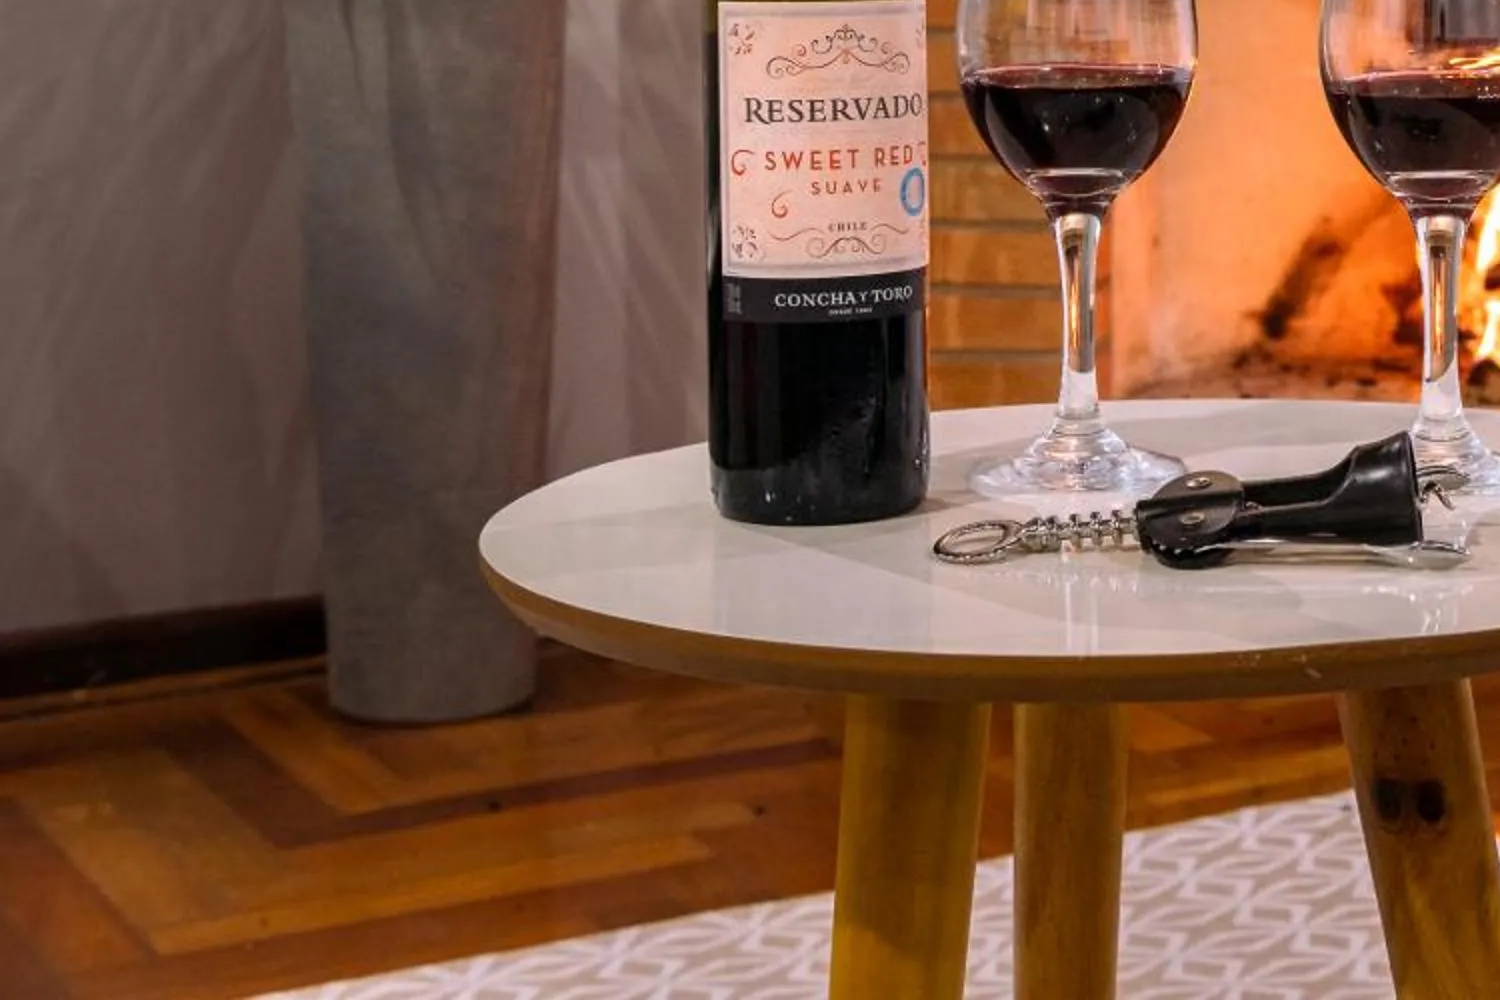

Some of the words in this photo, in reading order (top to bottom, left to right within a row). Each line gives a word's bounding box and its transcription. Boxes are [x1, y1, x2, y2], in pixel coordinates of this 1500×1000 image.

[744, 93, 922, 125] RESERVADO
[765, 149, 860, 171] SWEET
[875, 145, 913, 168] RED
[811, 178, 883, 195] SUAVE
[774, 291, 857, 307] CONCHA
[858, 291, 869, 302] Y
[871, 285, 913, 303] TORO
